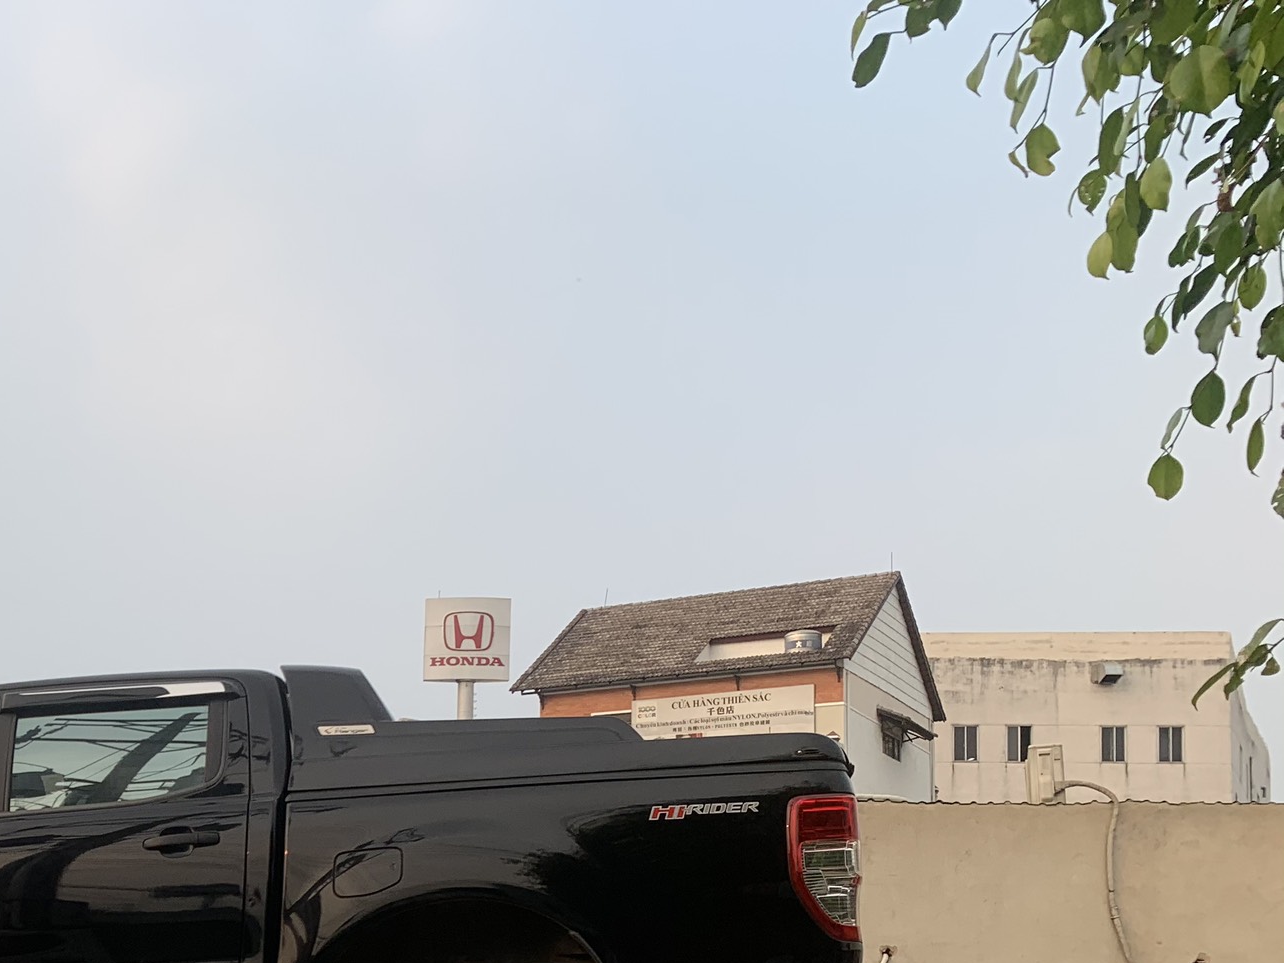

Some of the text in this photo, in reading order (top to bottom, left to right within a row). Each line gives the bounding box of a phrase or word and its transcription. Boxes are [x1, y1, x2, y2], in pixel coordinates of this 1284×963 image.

[429, 656, 505, 667] HONDA
[693, 696, 720, 708] HÀNG
[707, 705, 735, 716] 千色店
